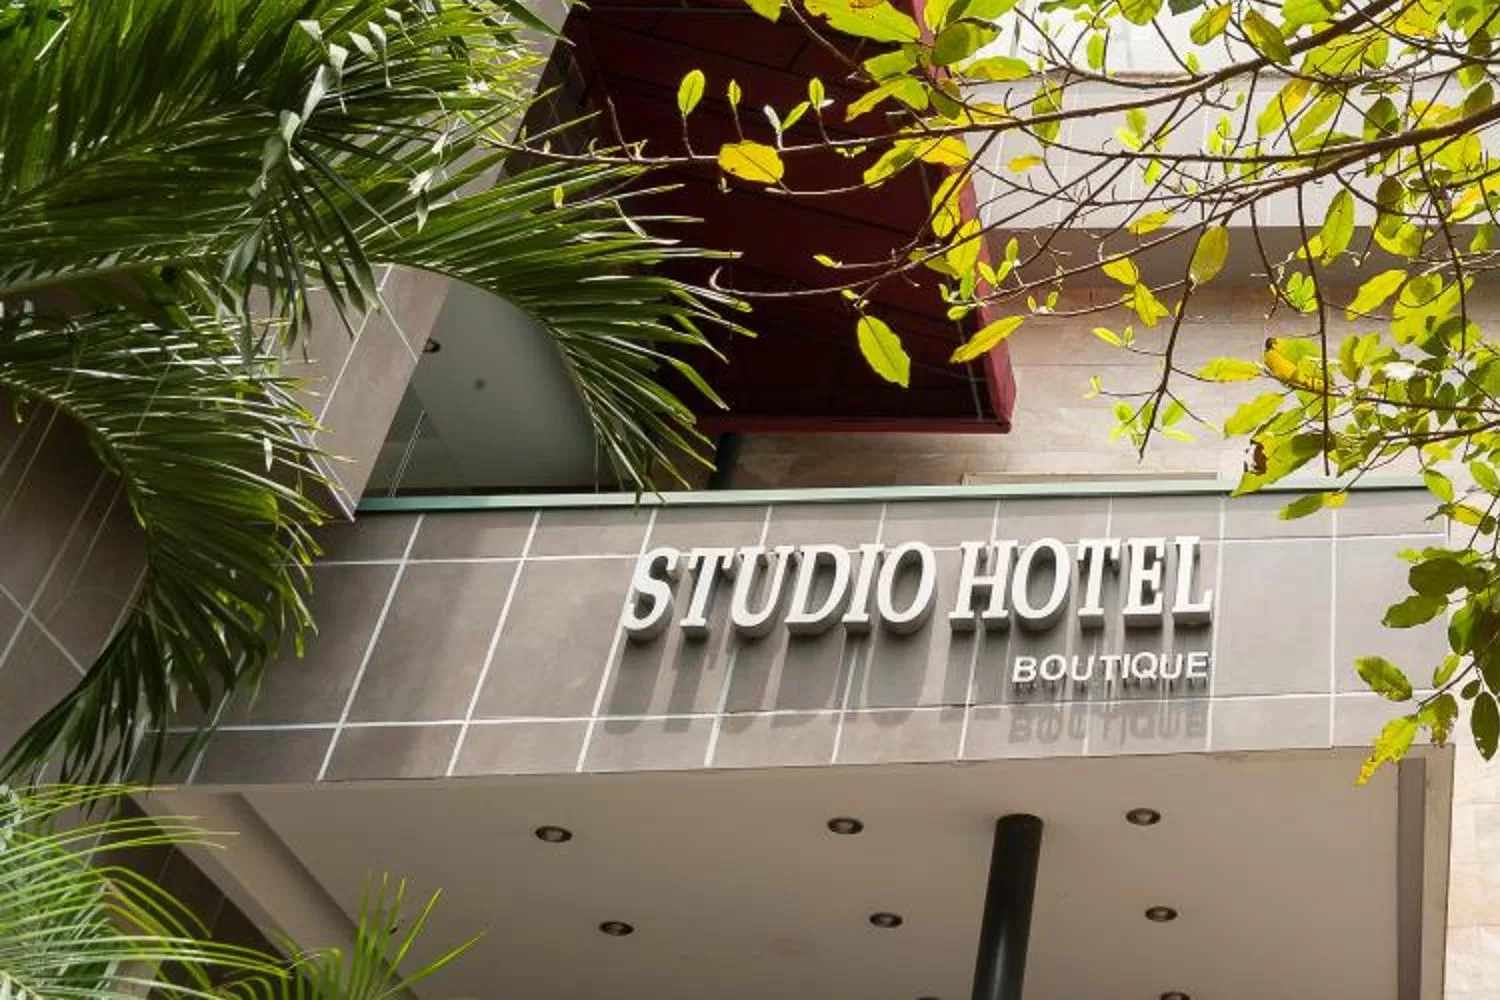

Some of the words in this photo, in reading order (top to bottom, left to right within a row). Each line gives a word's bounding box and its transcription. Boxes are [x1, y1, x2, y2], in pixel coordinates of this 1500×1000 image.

[623, 542, 937, 636] STUDIO
[949, 536, 1213, 630] HOTEL
[1011, 651, 1210, 684] BOUTIQUE
